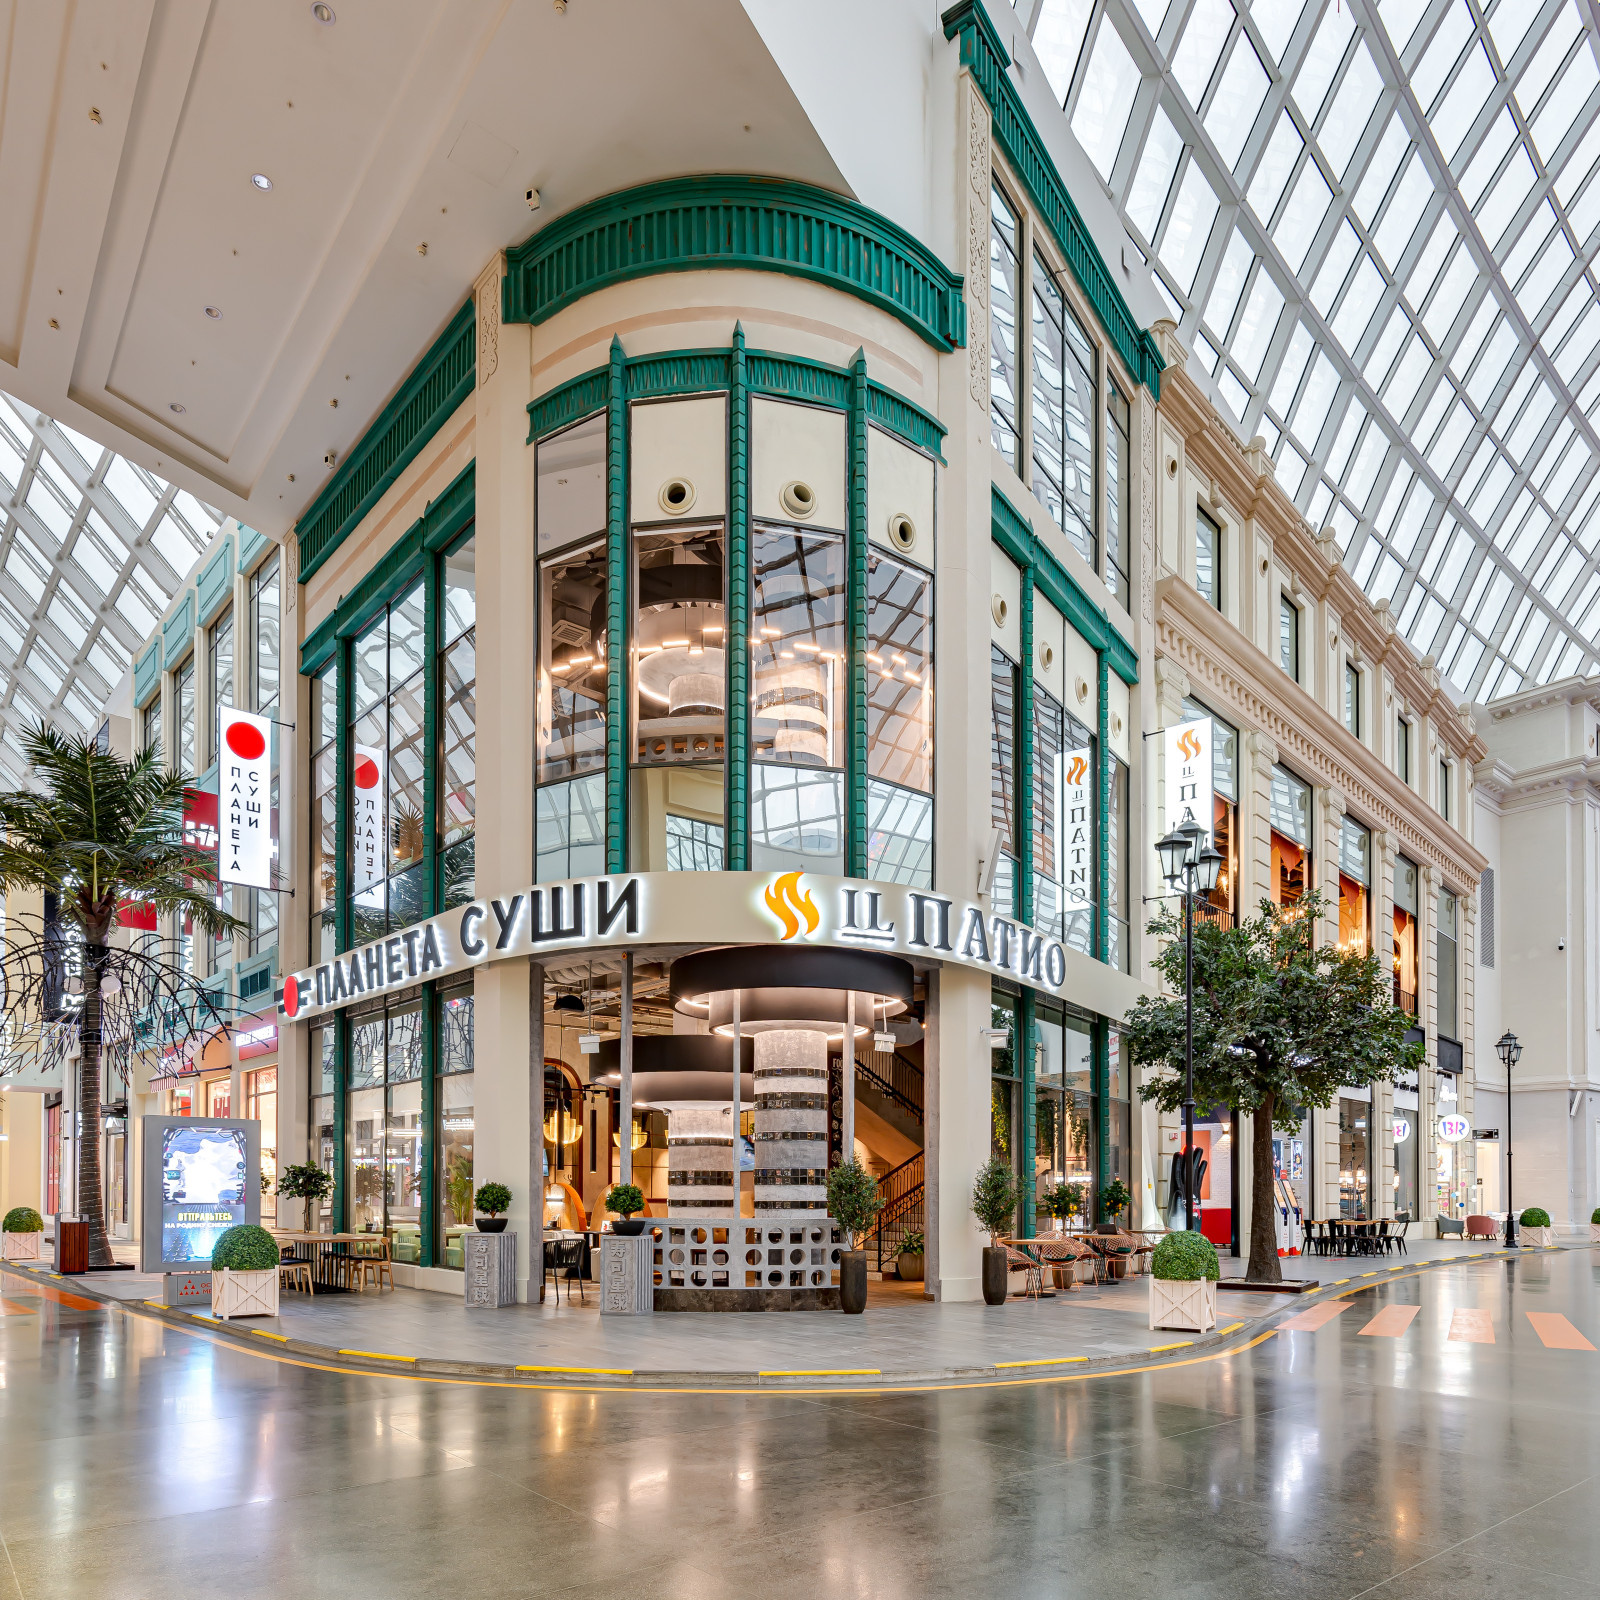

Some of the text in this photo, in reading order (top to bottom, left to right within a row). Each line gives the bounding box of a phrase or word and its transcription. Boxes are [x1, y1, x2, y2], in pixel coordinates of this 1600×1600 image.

[230, 766, 261, 871] ПЛАНЕТА СУШИ
[316, 878, 640, 1006] ПЛАНЕТА СУШИ
[841, 888, 1067, 988] IL ПАТИО
[177, 1212, 233, 1222] ОТПРАВЬТЕСЬ
